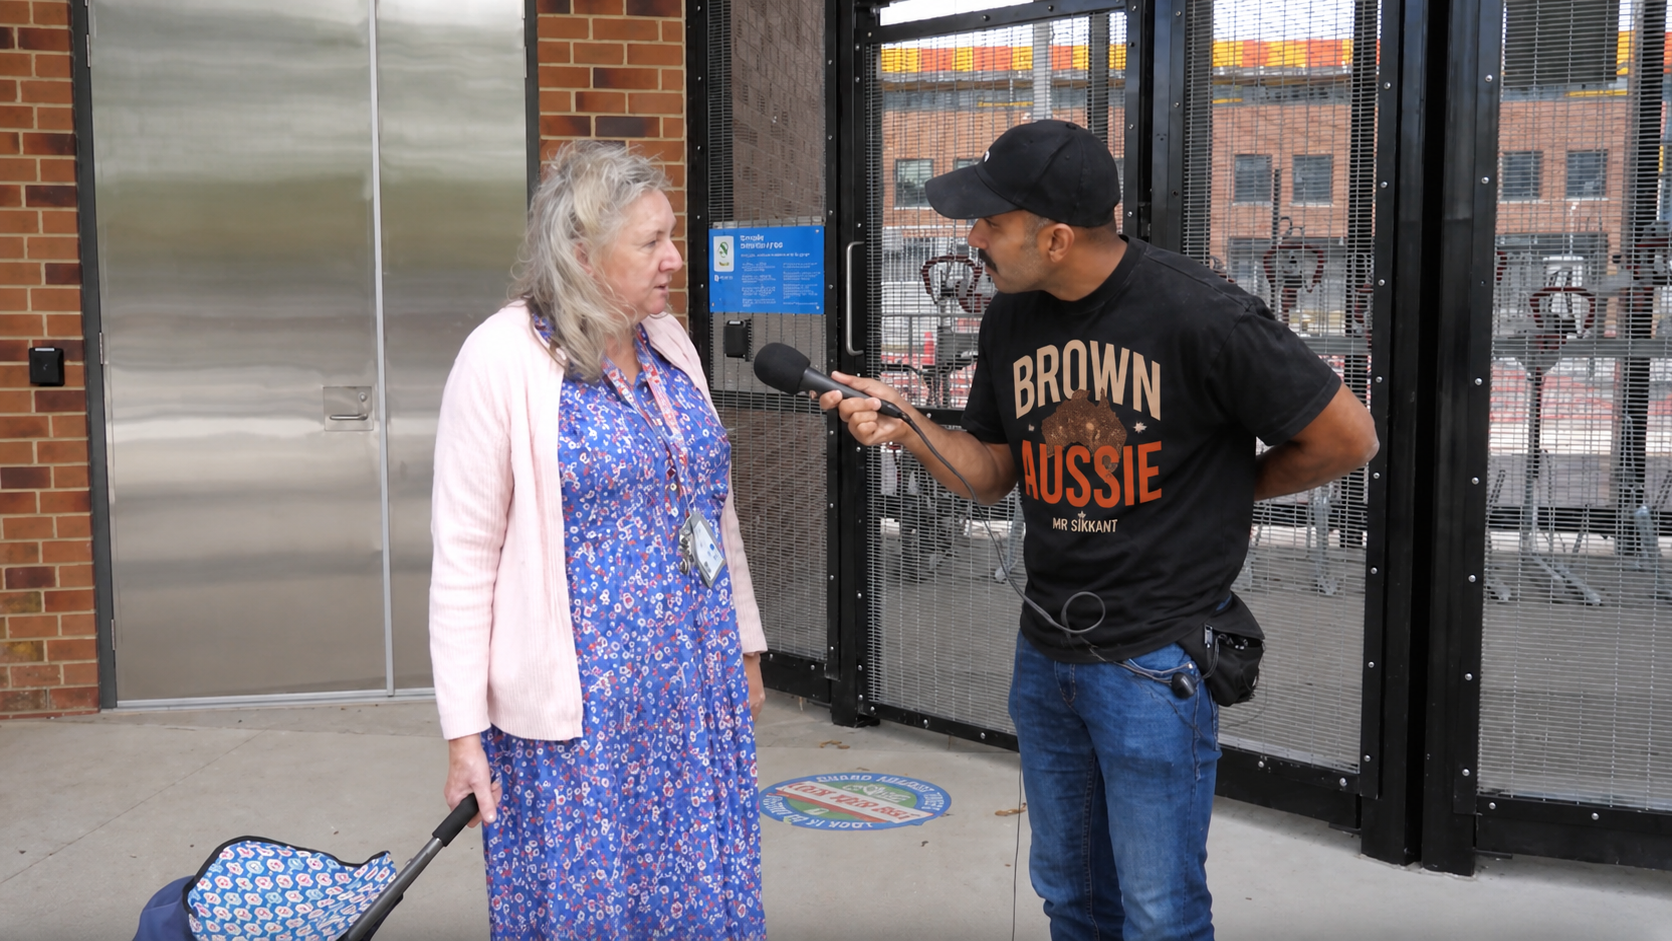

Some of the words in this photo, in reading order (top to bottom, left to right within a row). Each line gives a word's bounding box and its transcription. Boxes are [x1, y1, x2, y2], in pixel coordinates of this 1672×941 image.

[1013, 338, 1161, 421] BROWN
[1022, 440, 1162, 508] AUSSIE
[1052, 517, 1068, 531] MR
[1071, 518, 1118, 533] SIKKANT
